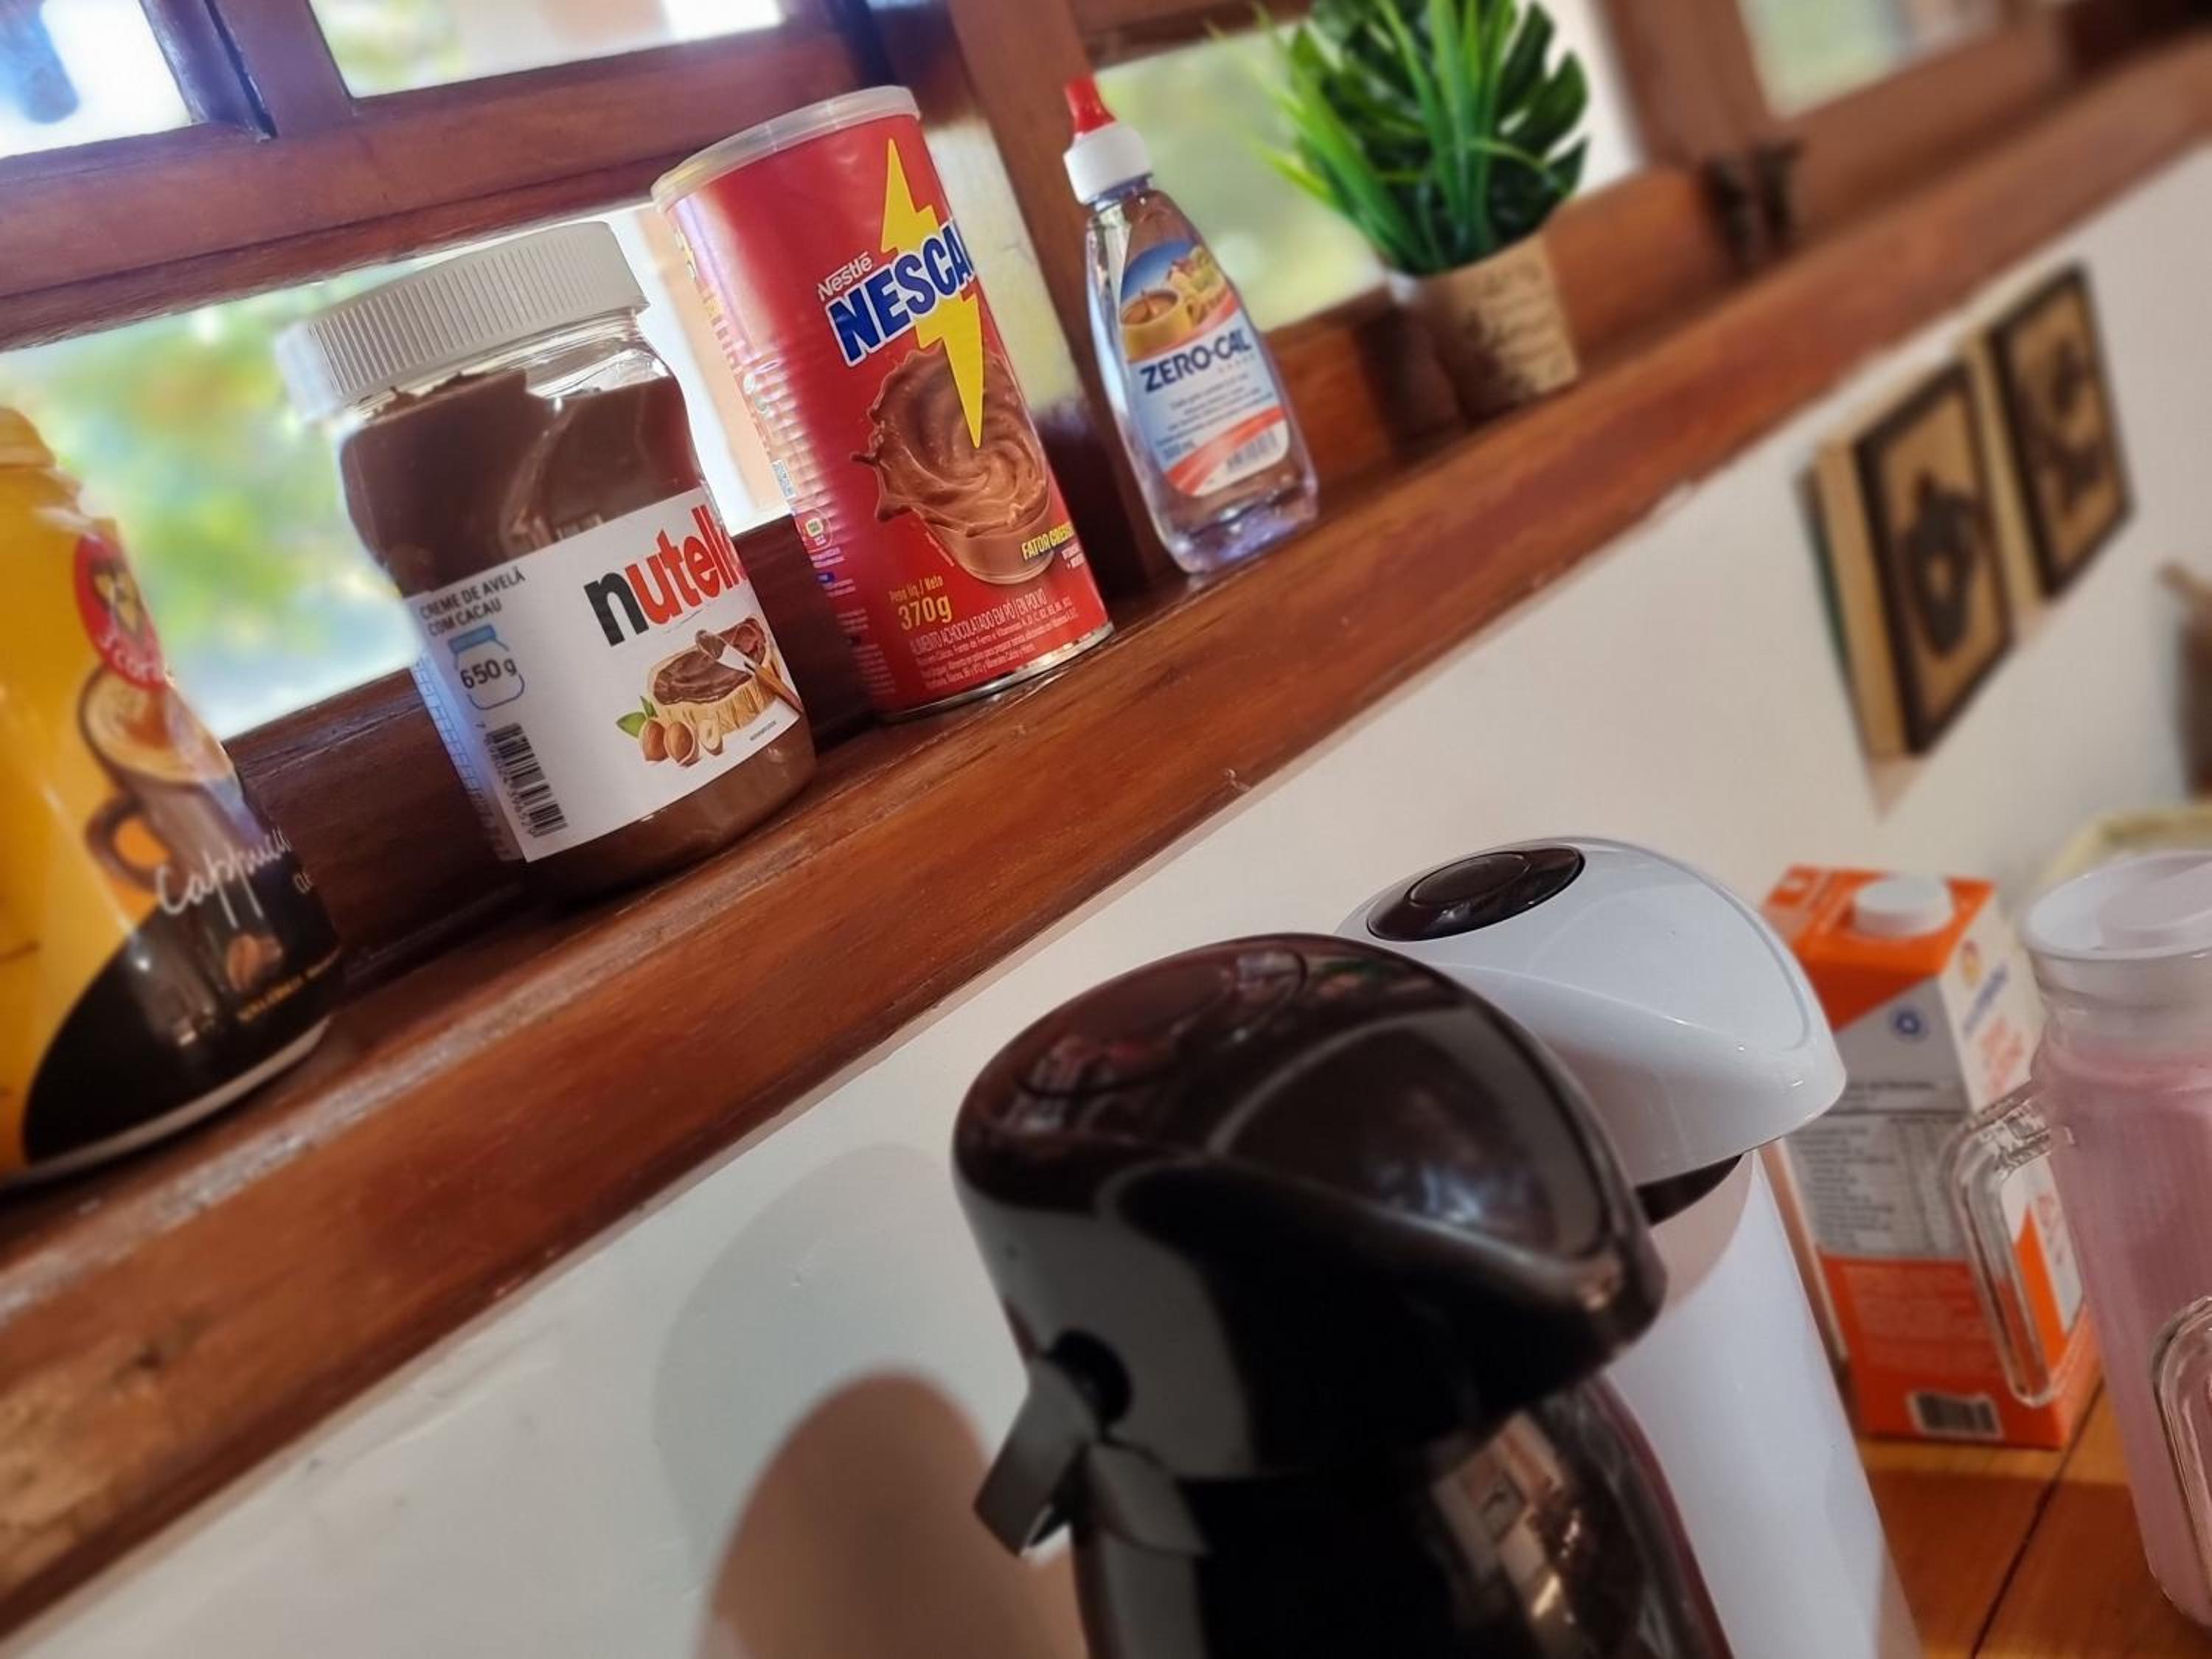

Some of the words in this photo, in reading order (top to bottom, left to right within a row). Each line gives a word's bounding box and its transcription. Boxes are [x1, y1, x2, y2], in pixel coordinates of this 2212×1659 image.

[817, 251, 874, 302] Nestlé
[826, 219, 976, 367] NESCA
[420, 594, 460, 620] CREME
[461, 586, 481, 604] DE
[428, 616, 455, 636] COM
[456, 598, 502, 626] CACAU
[898, 596, 953, 630] 370g
[460, 659, 501, 689] 650
[504, 658, 518, 676] g
